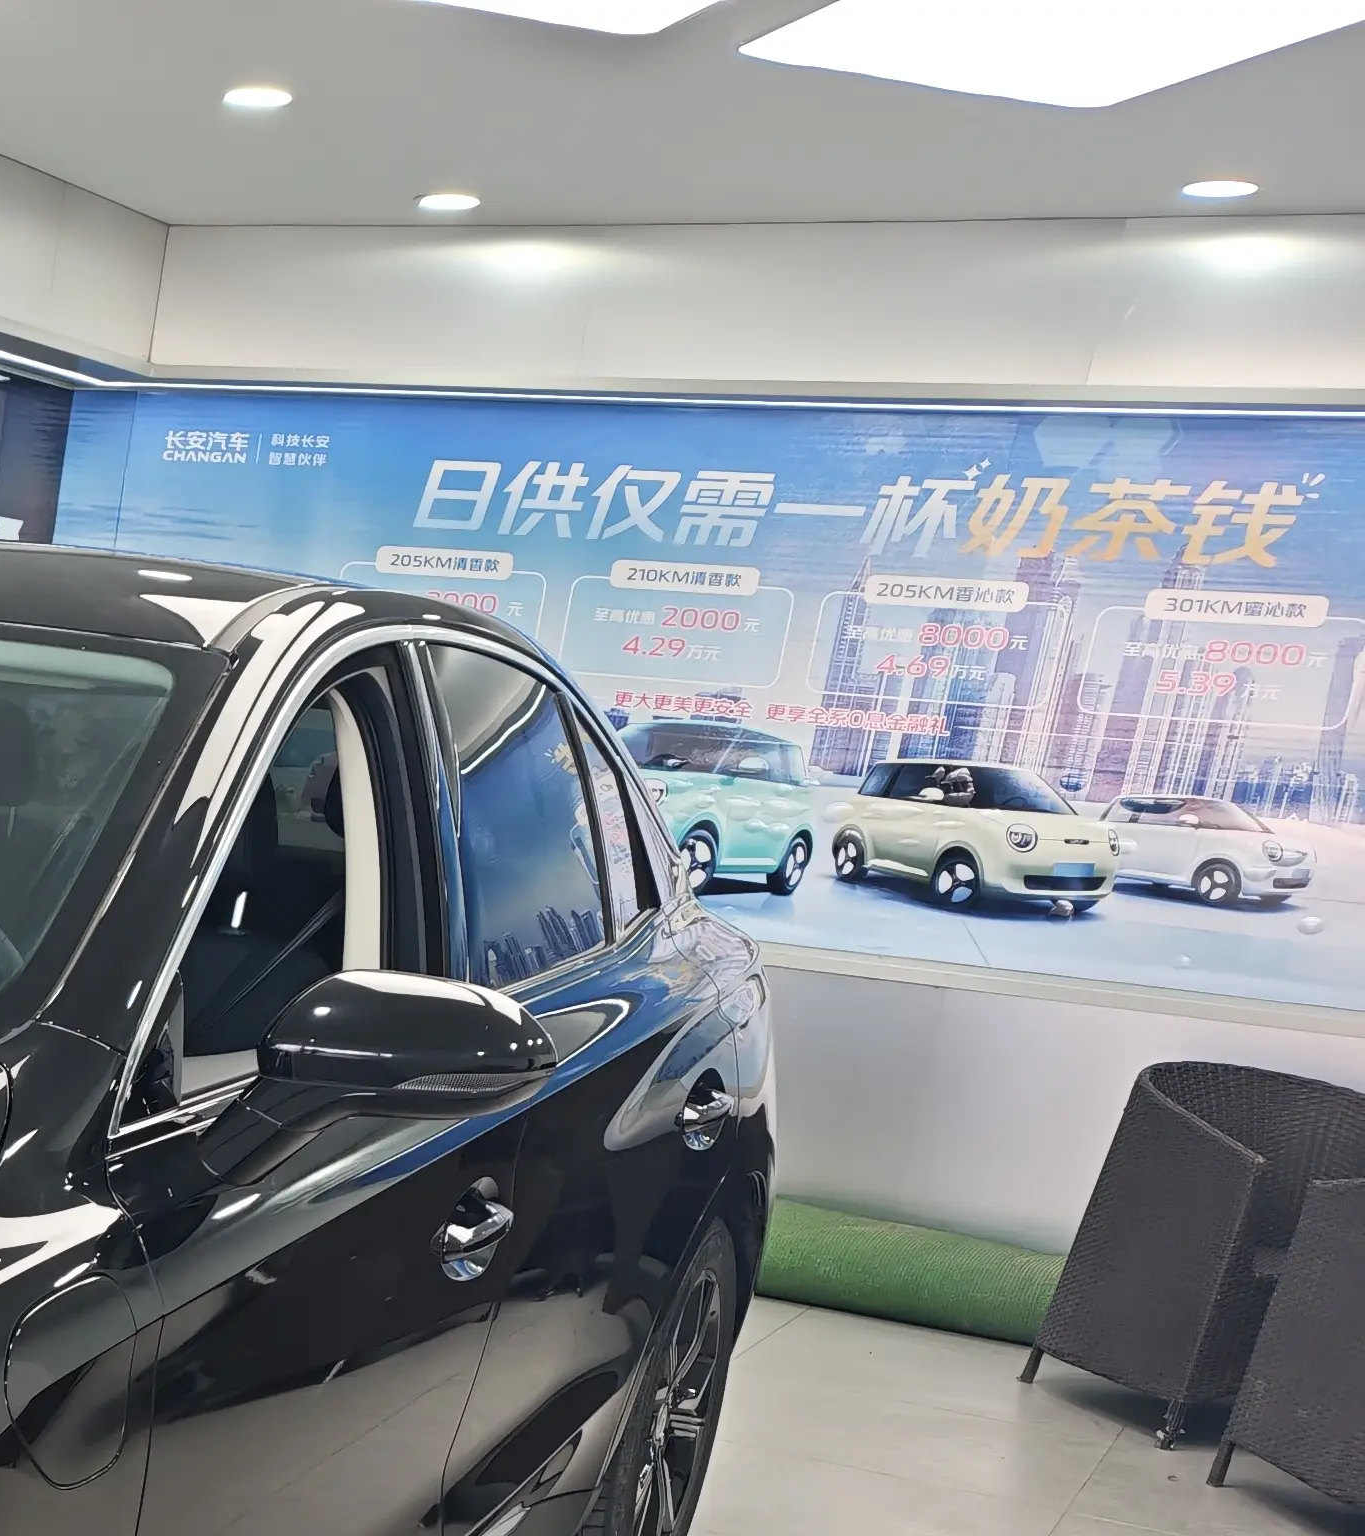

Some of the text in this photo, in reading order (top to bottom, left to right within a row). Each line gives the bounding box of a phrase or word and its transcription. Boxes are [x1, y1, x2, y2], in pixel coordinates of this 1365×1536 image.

[165, 430, 250, 451] 长安汽车
[270, 433, 331, 449] 科技长安
[162, 450, 247, 464] CHANGAN
[268, 451, 328, 467] 智慧伙伴
[413, 459, 1305, 568] 日供仅需一杯奶茶钱
[614, 690, 754, 719] 更大更美更安全
